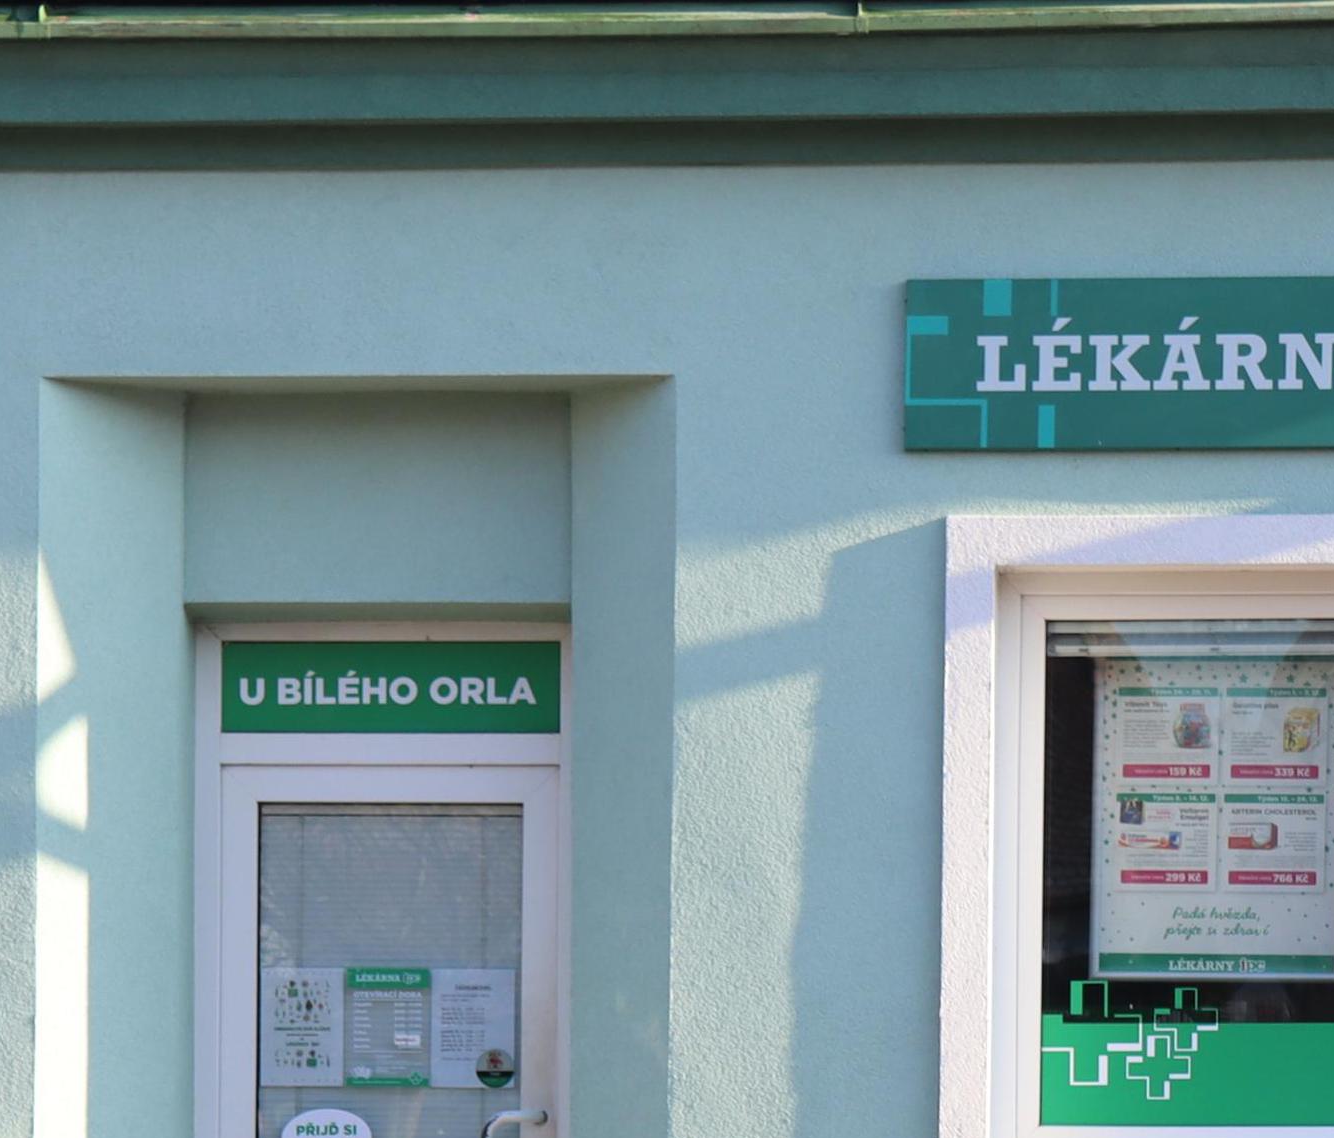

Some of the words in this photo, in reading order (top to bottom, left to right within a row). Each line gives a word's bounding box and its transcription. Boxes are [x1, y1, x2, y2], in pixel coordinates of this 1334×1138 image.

[239, 677, 265, 705] U
[277, 670, 417, 705] BÍLÉHO
[429, 676, 536, 705] ORLA
[1169, 767, 1187, 776] 159
[1189, 767, 1203, 776] Kč
[1274, 767, 1294, 777] 339
[1296, 767, 1310, 777] Kč
[1165, 872, 1186, 882] 299
[1188, 872, 1202, 882] Kč
[1295, 873, 1309, 883] Kč
[1172, 906, 1206, 919] Padá
[1210, 906, 1260, 921] hvězda,
[1223, 923, 1271, 936] zdraví
[1169, 957, 1235, 971] LÉKÁRNY
[296, 1122, 339, 1136] PŘIJĎ
[344, 1125, 357, 1136] SI
